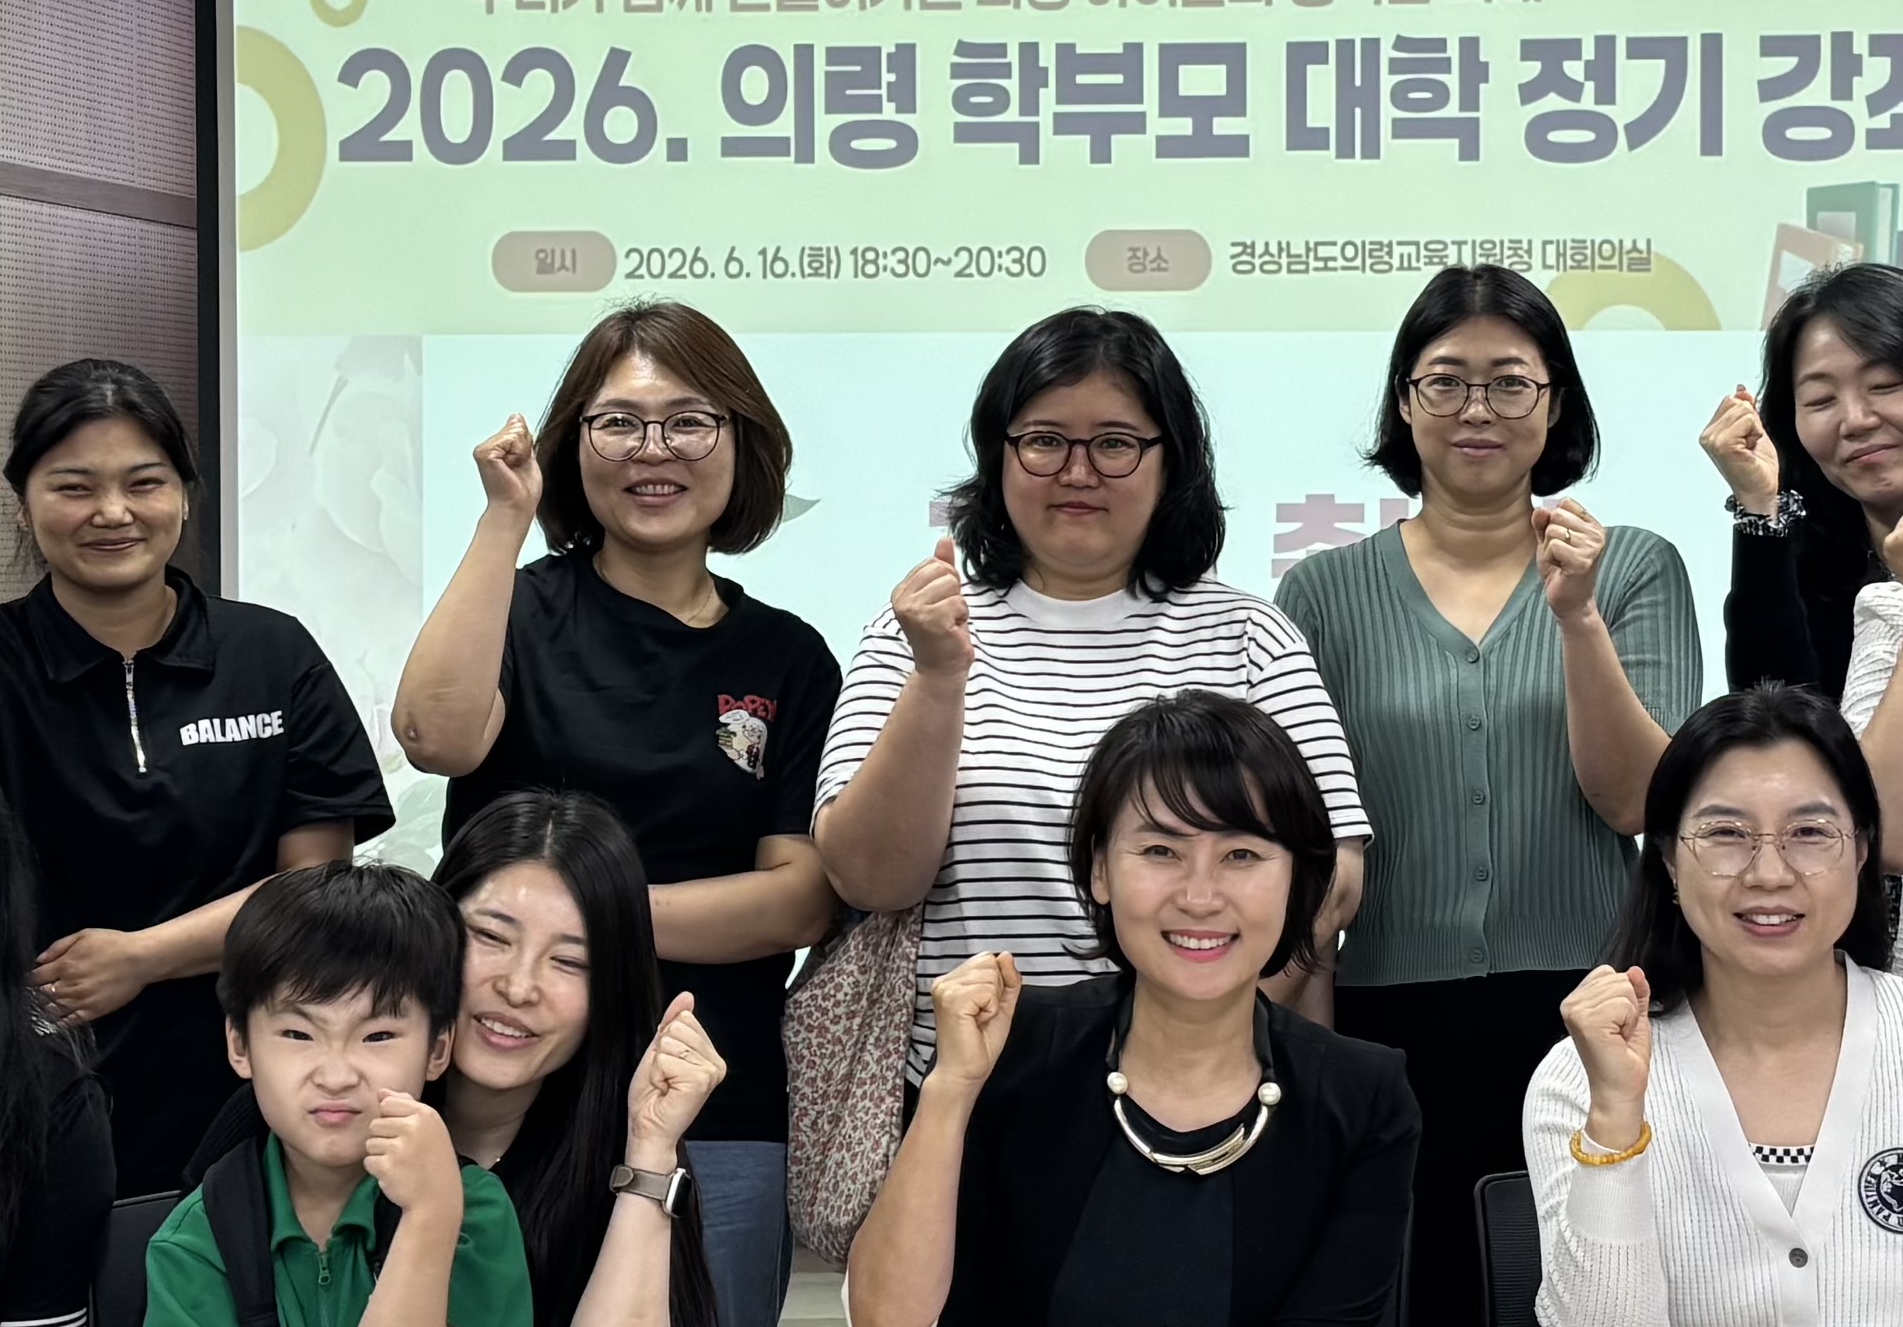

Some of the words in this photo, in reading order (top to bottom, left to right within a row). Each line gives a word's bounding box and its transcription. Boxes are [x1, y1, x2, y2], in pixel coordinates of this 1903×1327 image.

[337, 47, 688, 165] 2026.
[721, 43, 918, 169] 의령
[950, 39, 1250, 165] 학부모
[1286, 34, 1489, 161] 대학
[1518, 33, 1723, 163] 정기
[535, 248, 576, 274] 일시
[625, 246, 715, 279] 2026.
[724, 246, 750, 279] 6.
[758, 246, 841, 279] 16.(화)
[850, 246, 1046, 279] 18:30~20:30
[1128, 246, 1169, 273] 장소
[1229, 239, 1532, 274] 경상남도의령교육지원청
[1541, 238, 1652, 272] 대회의실
[180, 711, 284, 745] BALANCE
